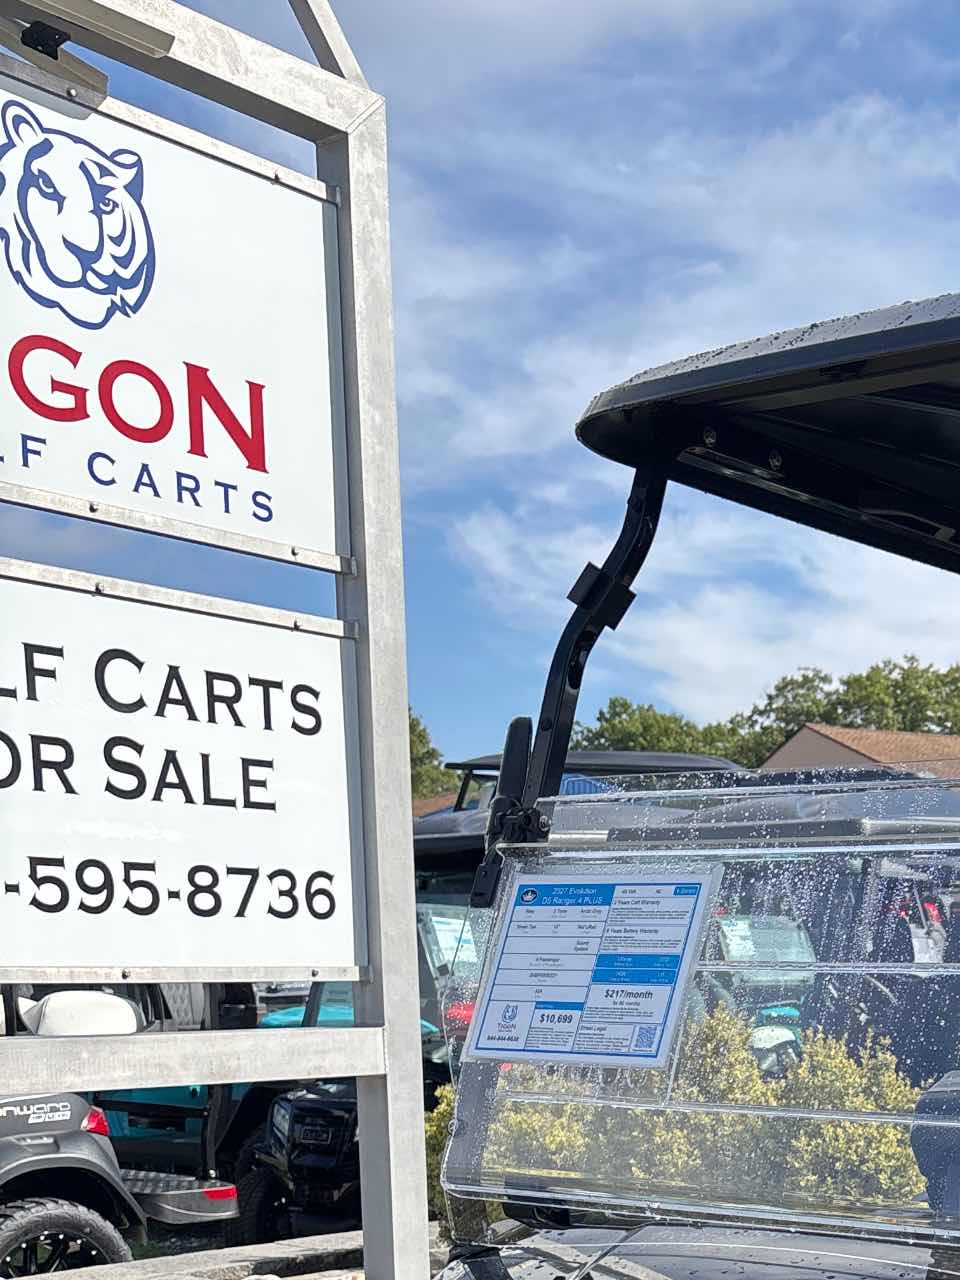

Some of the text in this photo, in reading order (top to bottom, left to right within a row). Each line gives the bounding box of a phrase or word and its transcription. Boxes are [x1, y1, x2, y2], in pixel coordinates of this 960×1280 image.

[8, 335, 269, 473] GON
[88, 452, 274, 523] CARTS
[94, 648, 322, 736] CARTS
[103, 736, 277, 812] SALE
[4, 856, 336, 920] -595-8736
[583, 896, 604, 905] PLUS
[539, 1013, 573, 1024] $10,699
[604, 989, 653, 999] $217/month
